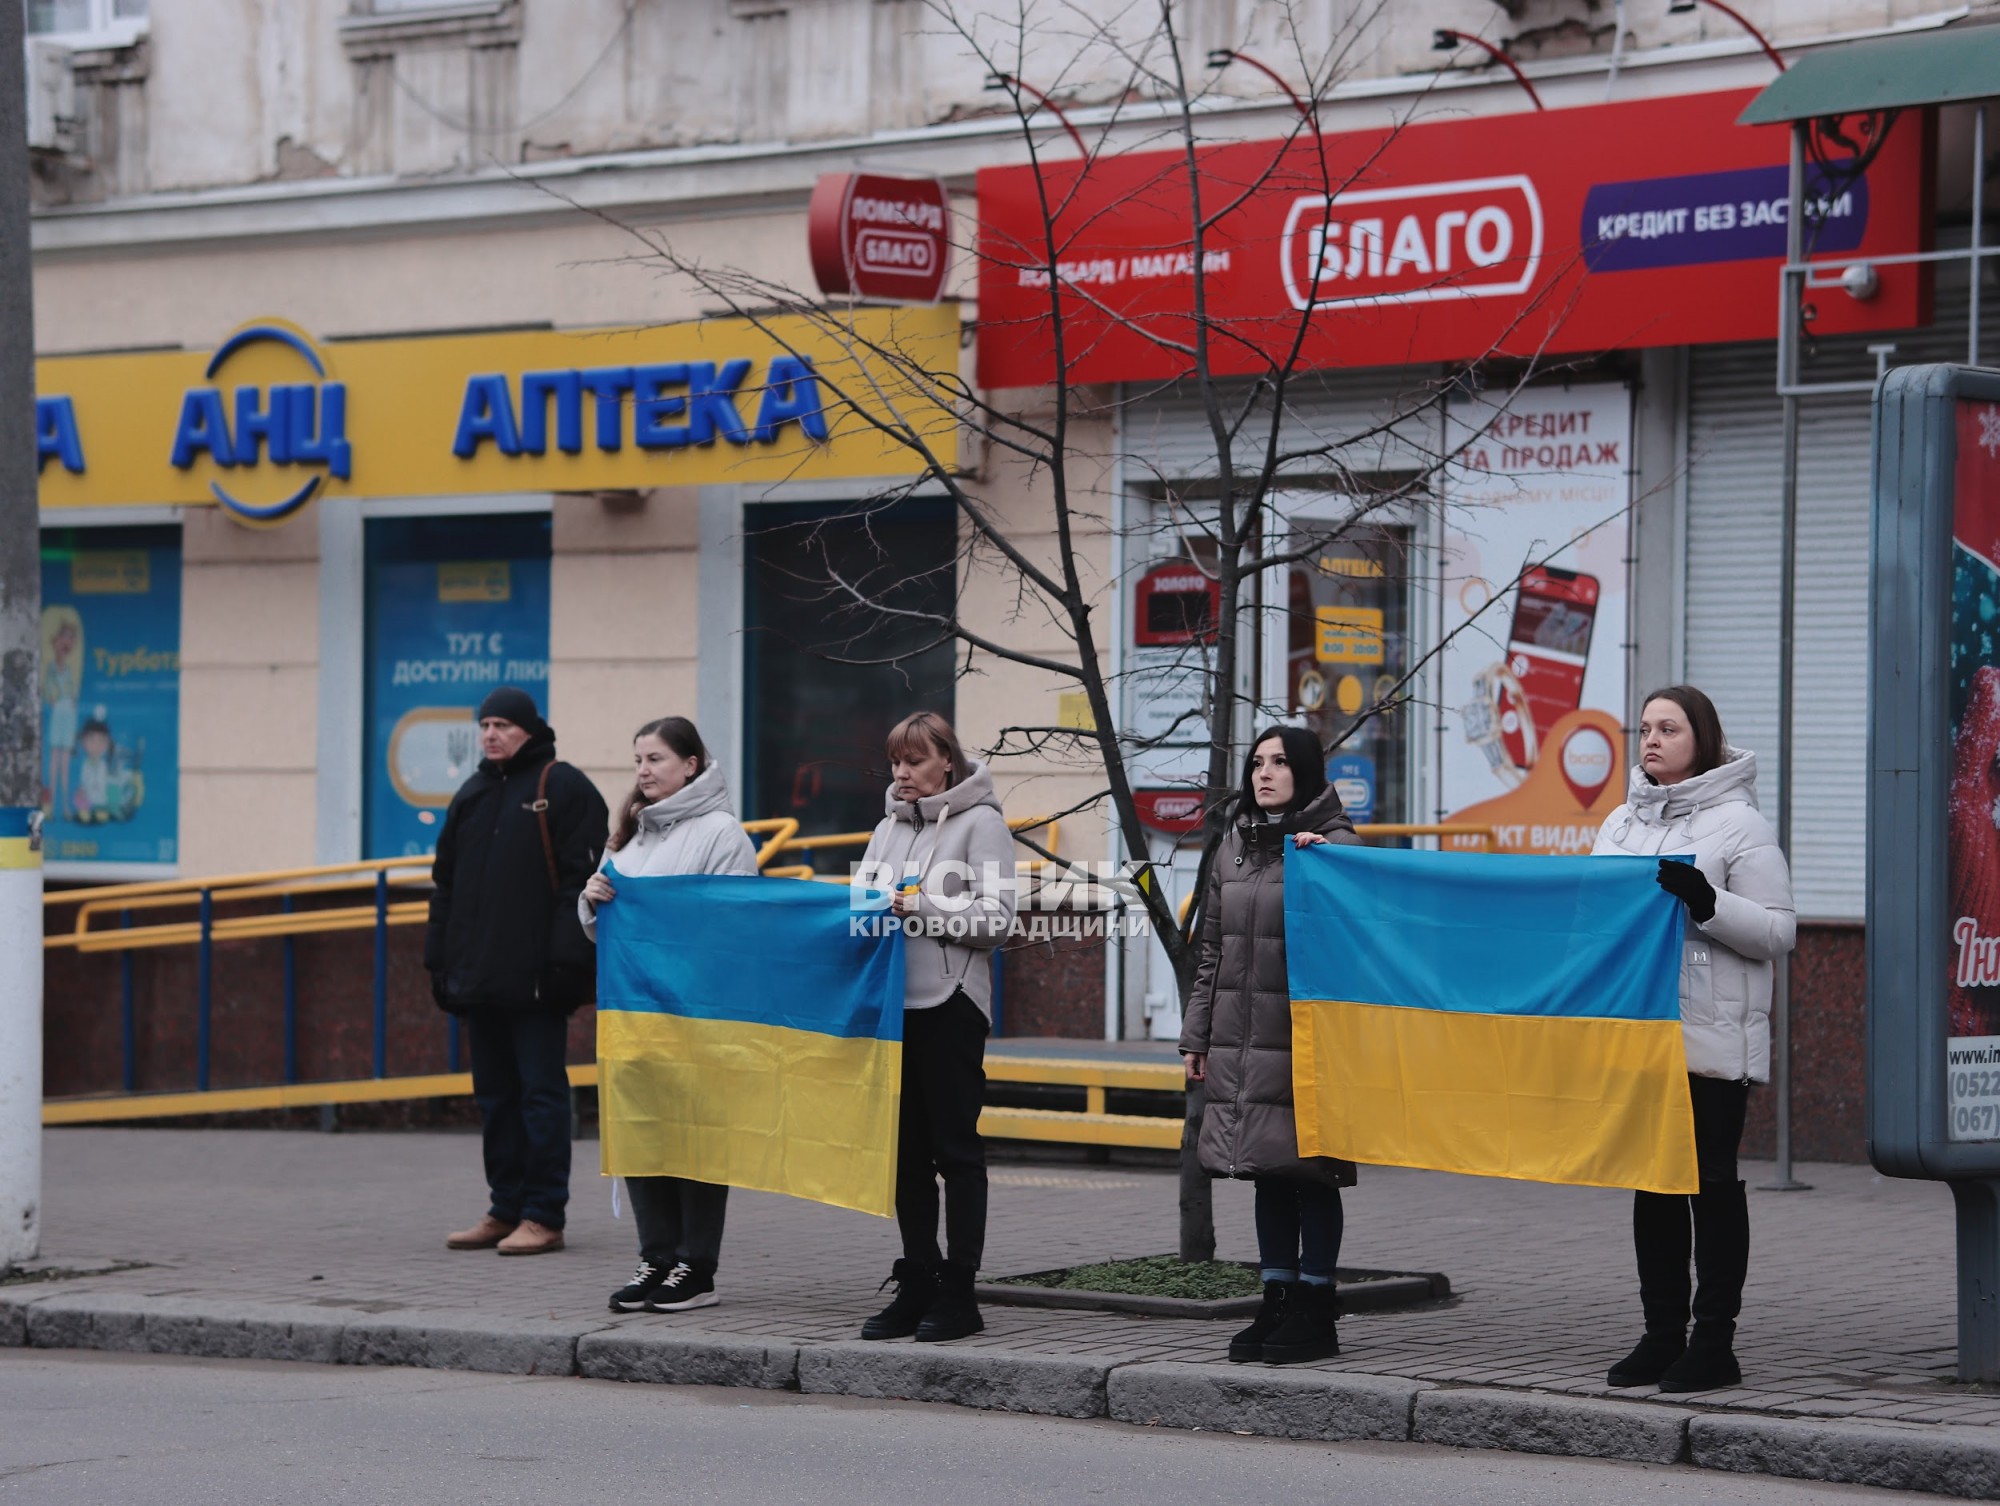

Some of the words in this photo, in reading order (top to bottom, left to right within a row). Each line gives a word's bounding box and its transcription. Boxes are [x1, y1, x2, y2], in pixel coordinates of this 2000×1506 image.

[852, 197, 943, 230] ЛОМБАРД
[1598, 208, 1688, 240] КРЕДИТ
[1694, 203, 1736, 232] БЕЗ
[865, 239, 928, 266] БЛАГО
[1308, 206, 1513, 283] БЛАГО
[452, 354, 828, 457] АПТЕКА
[170, 382, 352, 480] АНЦ
[1488, 410, 1591, 440] КРЕДИТ
[1501, 442, 1620, 469] ПРОДАЖ
[447, 633, 484, 655] ТУТ
[393, 660, 499, 686] ДОСТУПНІ
[1694, 951, 1706, 962] M
[1951, 1104, 2000, 1137] (067)
